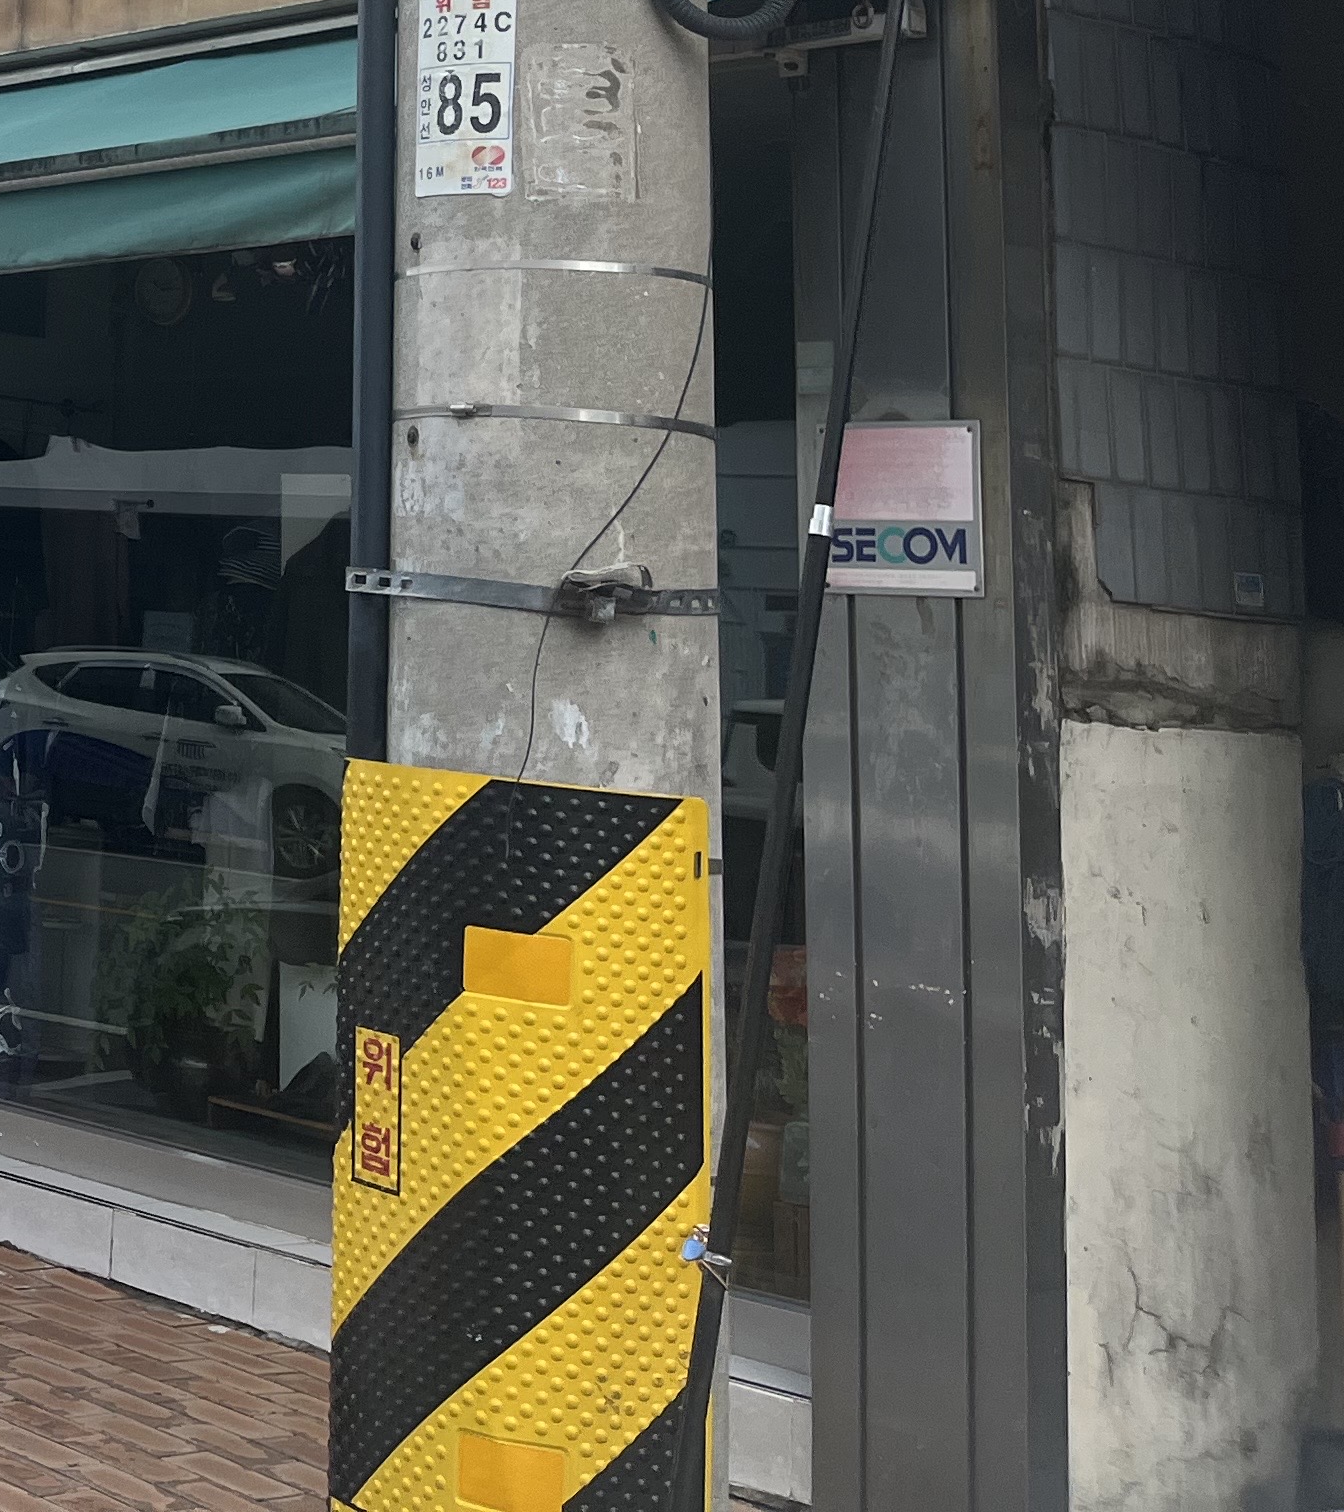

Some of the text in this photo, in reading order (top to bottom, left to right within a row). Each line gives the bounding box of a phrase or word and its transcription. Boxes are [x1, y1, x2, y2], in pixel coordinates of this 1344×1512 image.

[436, 39, 484, 63] 831
[420, 74, 433, 140] 성안선
[437, 71, 502, 136] 85
[418, 166, 445, 181] 16M
[486, 177, 507, 189] 123
[831, 526, 968, 565] SECOM
[362, 1037, 392, 1177] 위험
